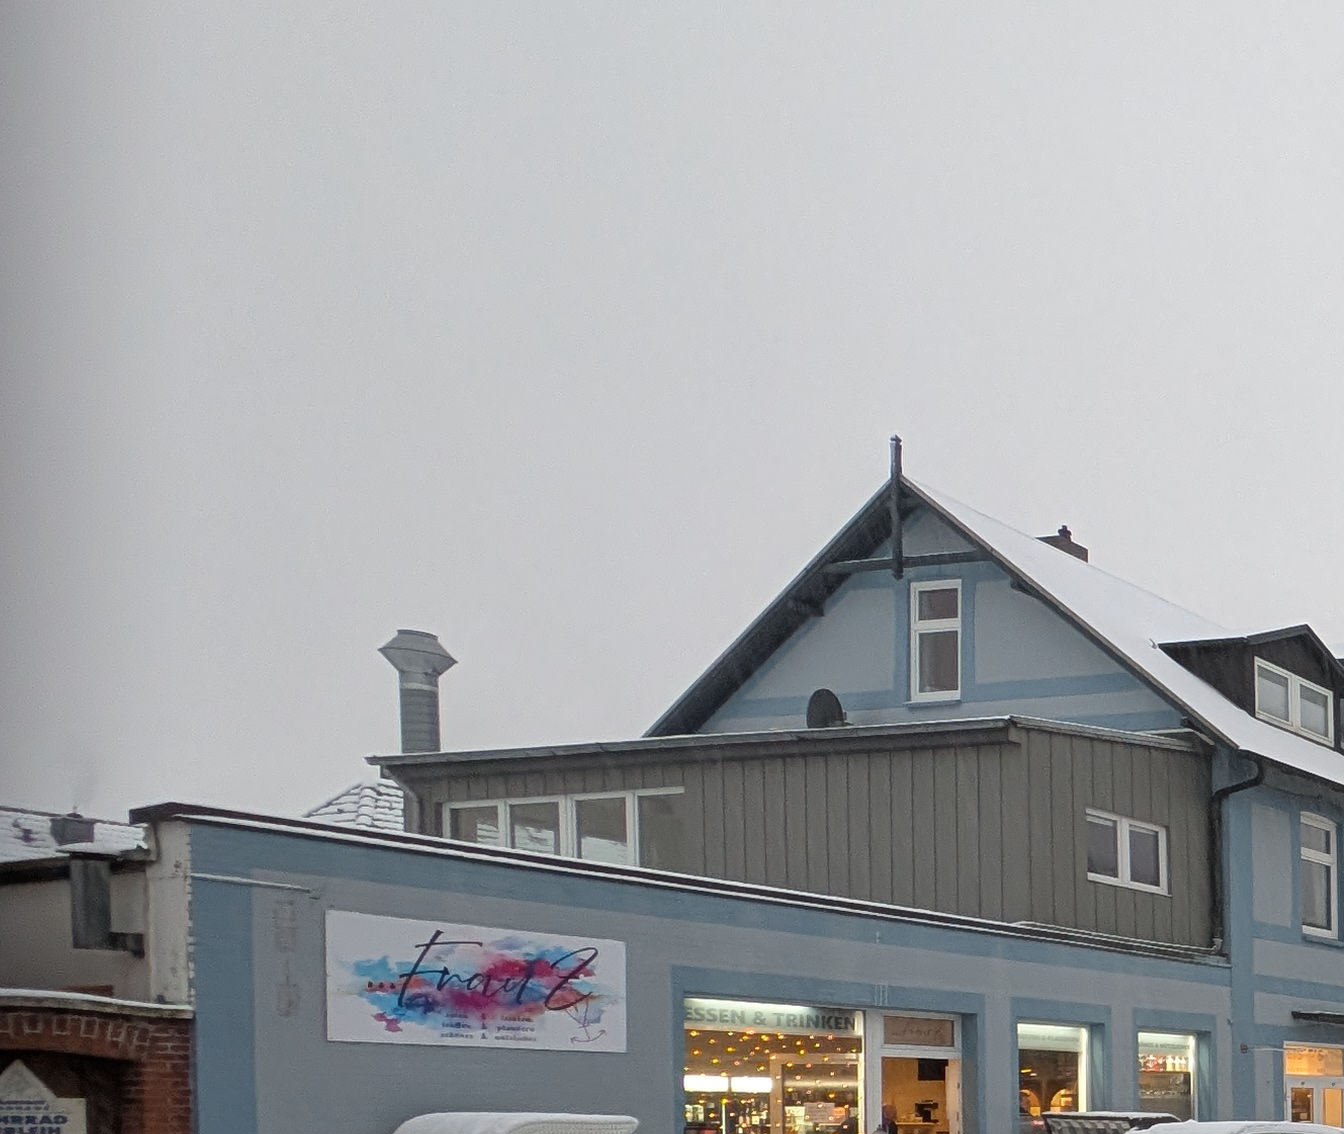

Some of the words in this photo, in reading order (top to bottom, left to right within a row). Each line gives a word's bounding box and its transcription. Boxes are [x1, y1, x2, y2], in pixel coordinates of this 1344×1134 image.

[685, 1006, 747, 1025] ESSEN
[752, 1010, 767, 1026] &
[771, 1012, 856, 1032] TRINKEN
